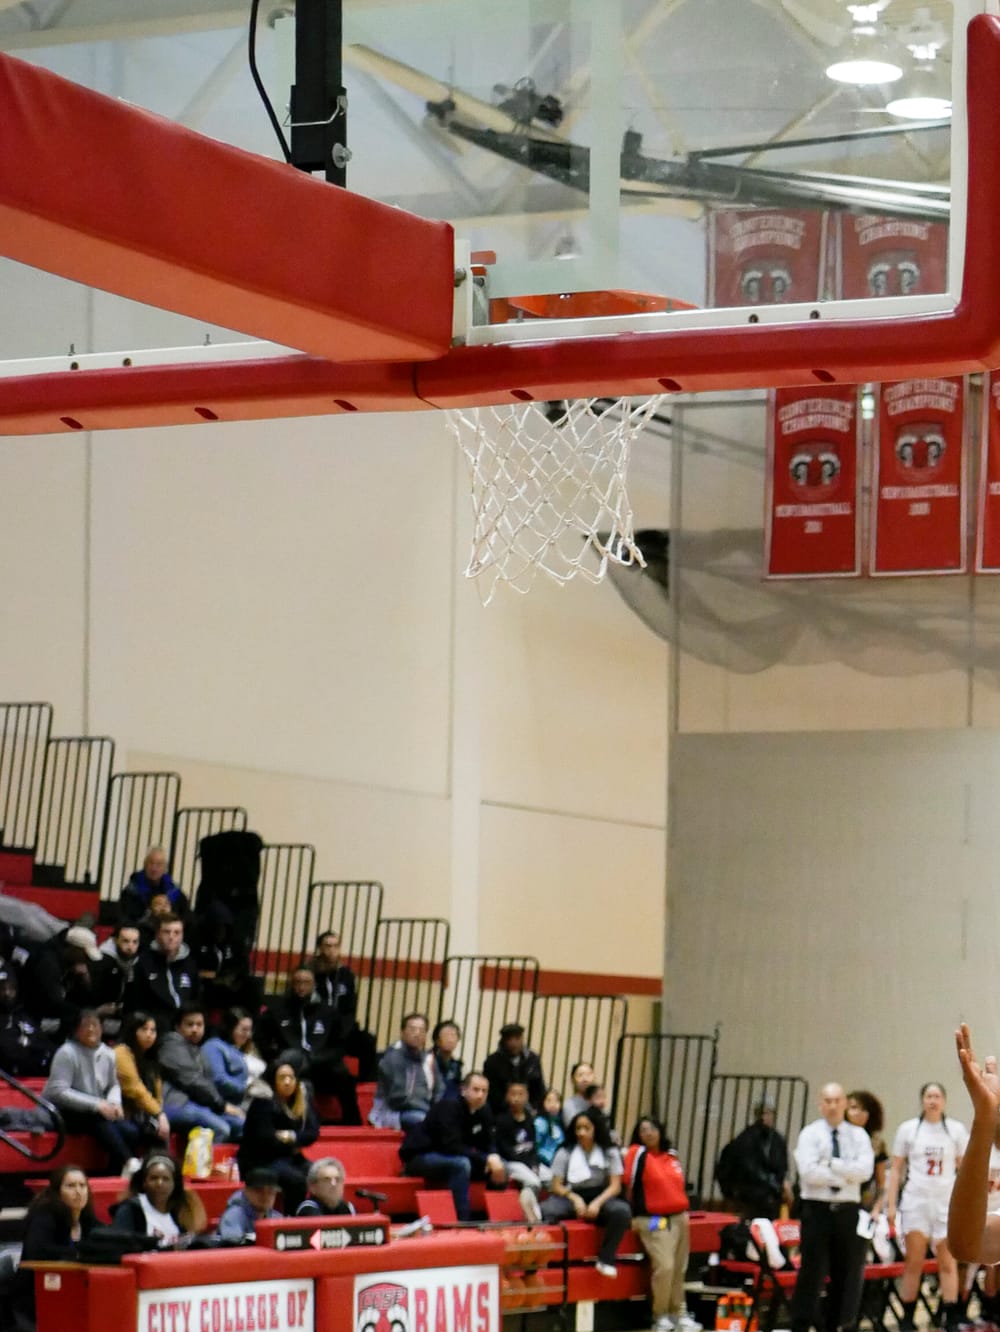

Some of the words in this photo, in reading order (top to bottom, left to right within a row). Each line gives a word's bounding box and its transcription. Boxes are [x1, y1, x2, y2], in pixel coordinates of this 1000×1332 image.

[884, 379, 960, 402] CONFERENCE
[778, 398, 854, 422] CONFERENCE
[286, 1289, 308, 1328] OF
